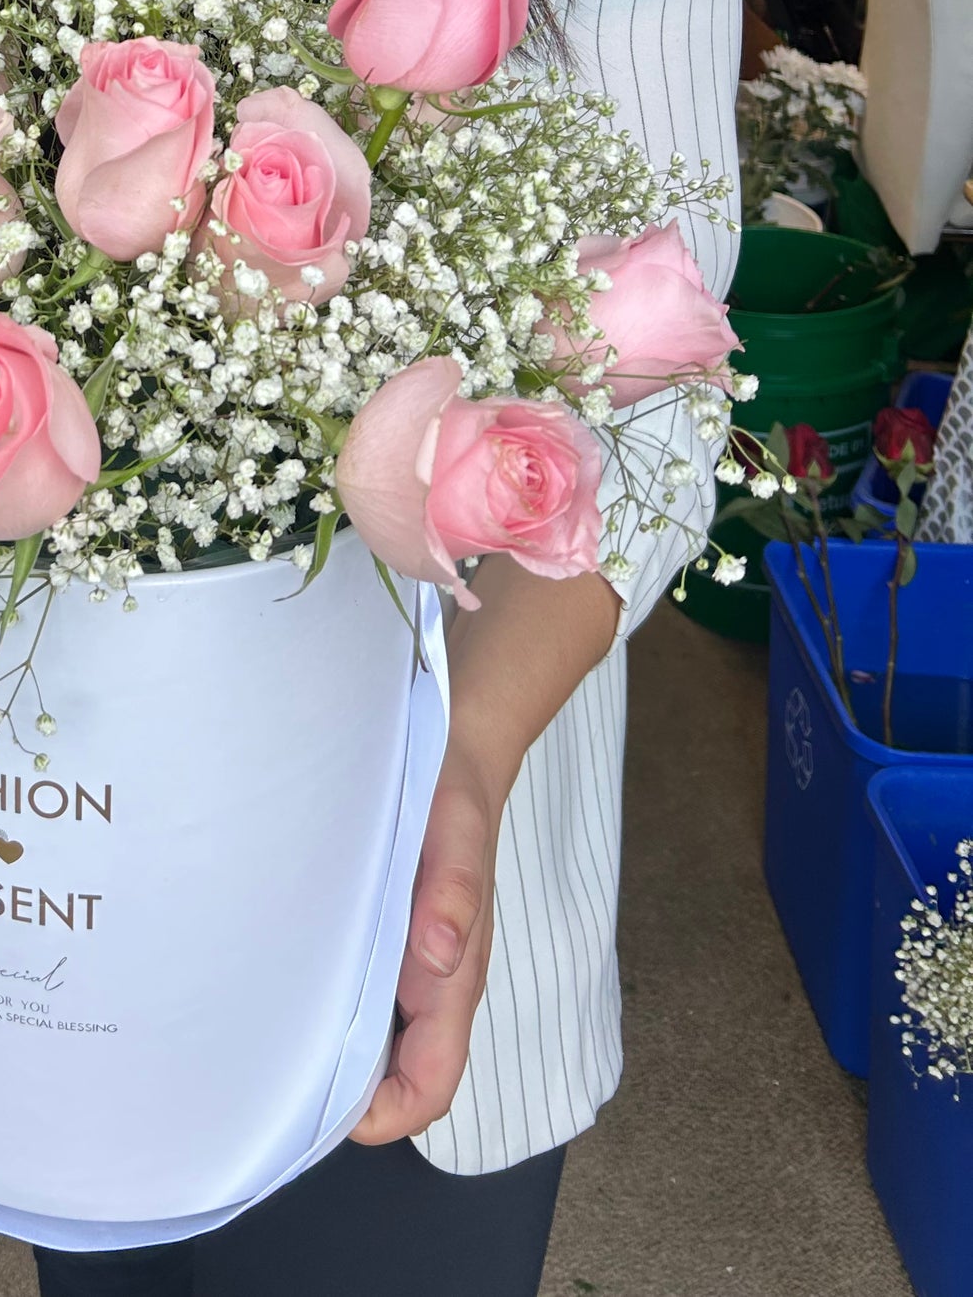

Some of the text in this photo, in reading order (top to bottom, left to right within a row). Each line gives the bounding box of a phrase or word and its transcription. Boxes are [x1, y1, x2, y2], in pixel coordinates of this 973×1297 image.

[21, 1000, 51, 1014] YOU
[6, 1011, 54, 1030] SPECIAL
[57, 1020, 118, 1033] BLESSING
